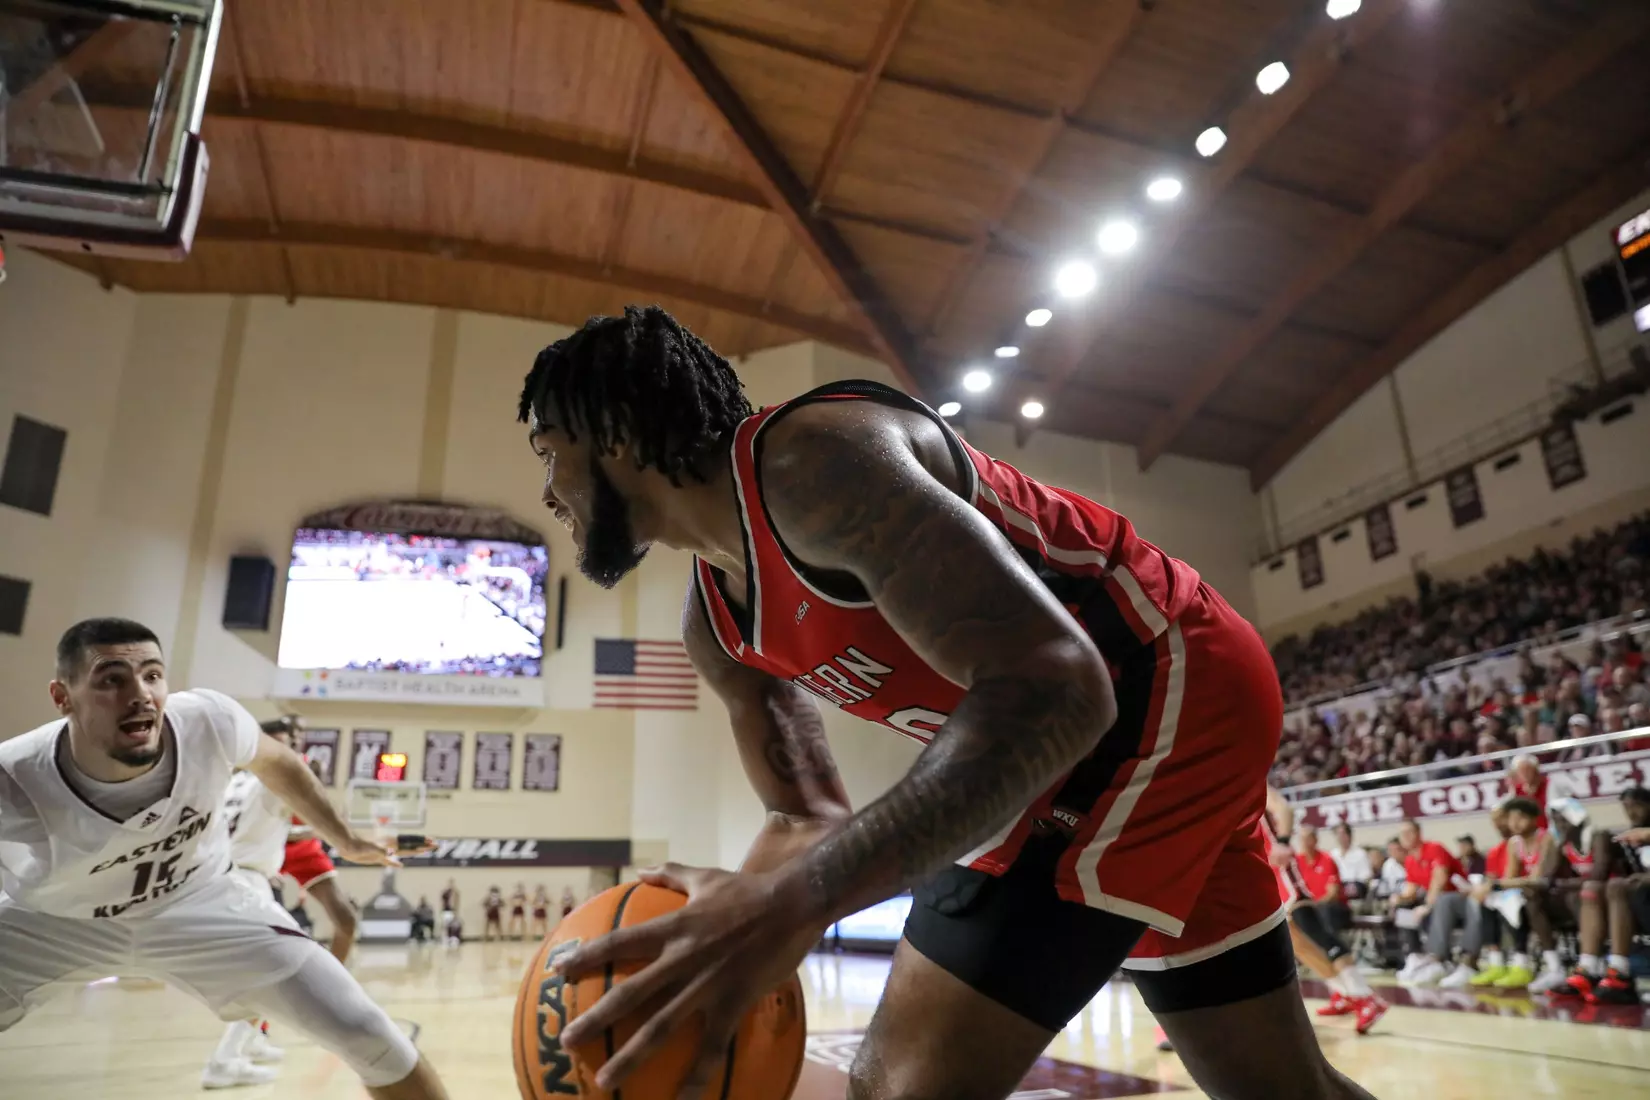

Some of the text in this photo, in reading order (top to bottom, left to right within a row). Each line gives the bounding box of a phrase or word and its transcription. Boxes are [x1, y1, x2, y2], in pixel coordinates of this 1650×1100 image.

[792, 645, 895, 708] ERN
[1318, 793, 1404, 828] THE
[1419, 758, 1650, 816] COLNE
[1052, 809, 1079, 827] WKU
[430, 838, 538, 860] YBALL
